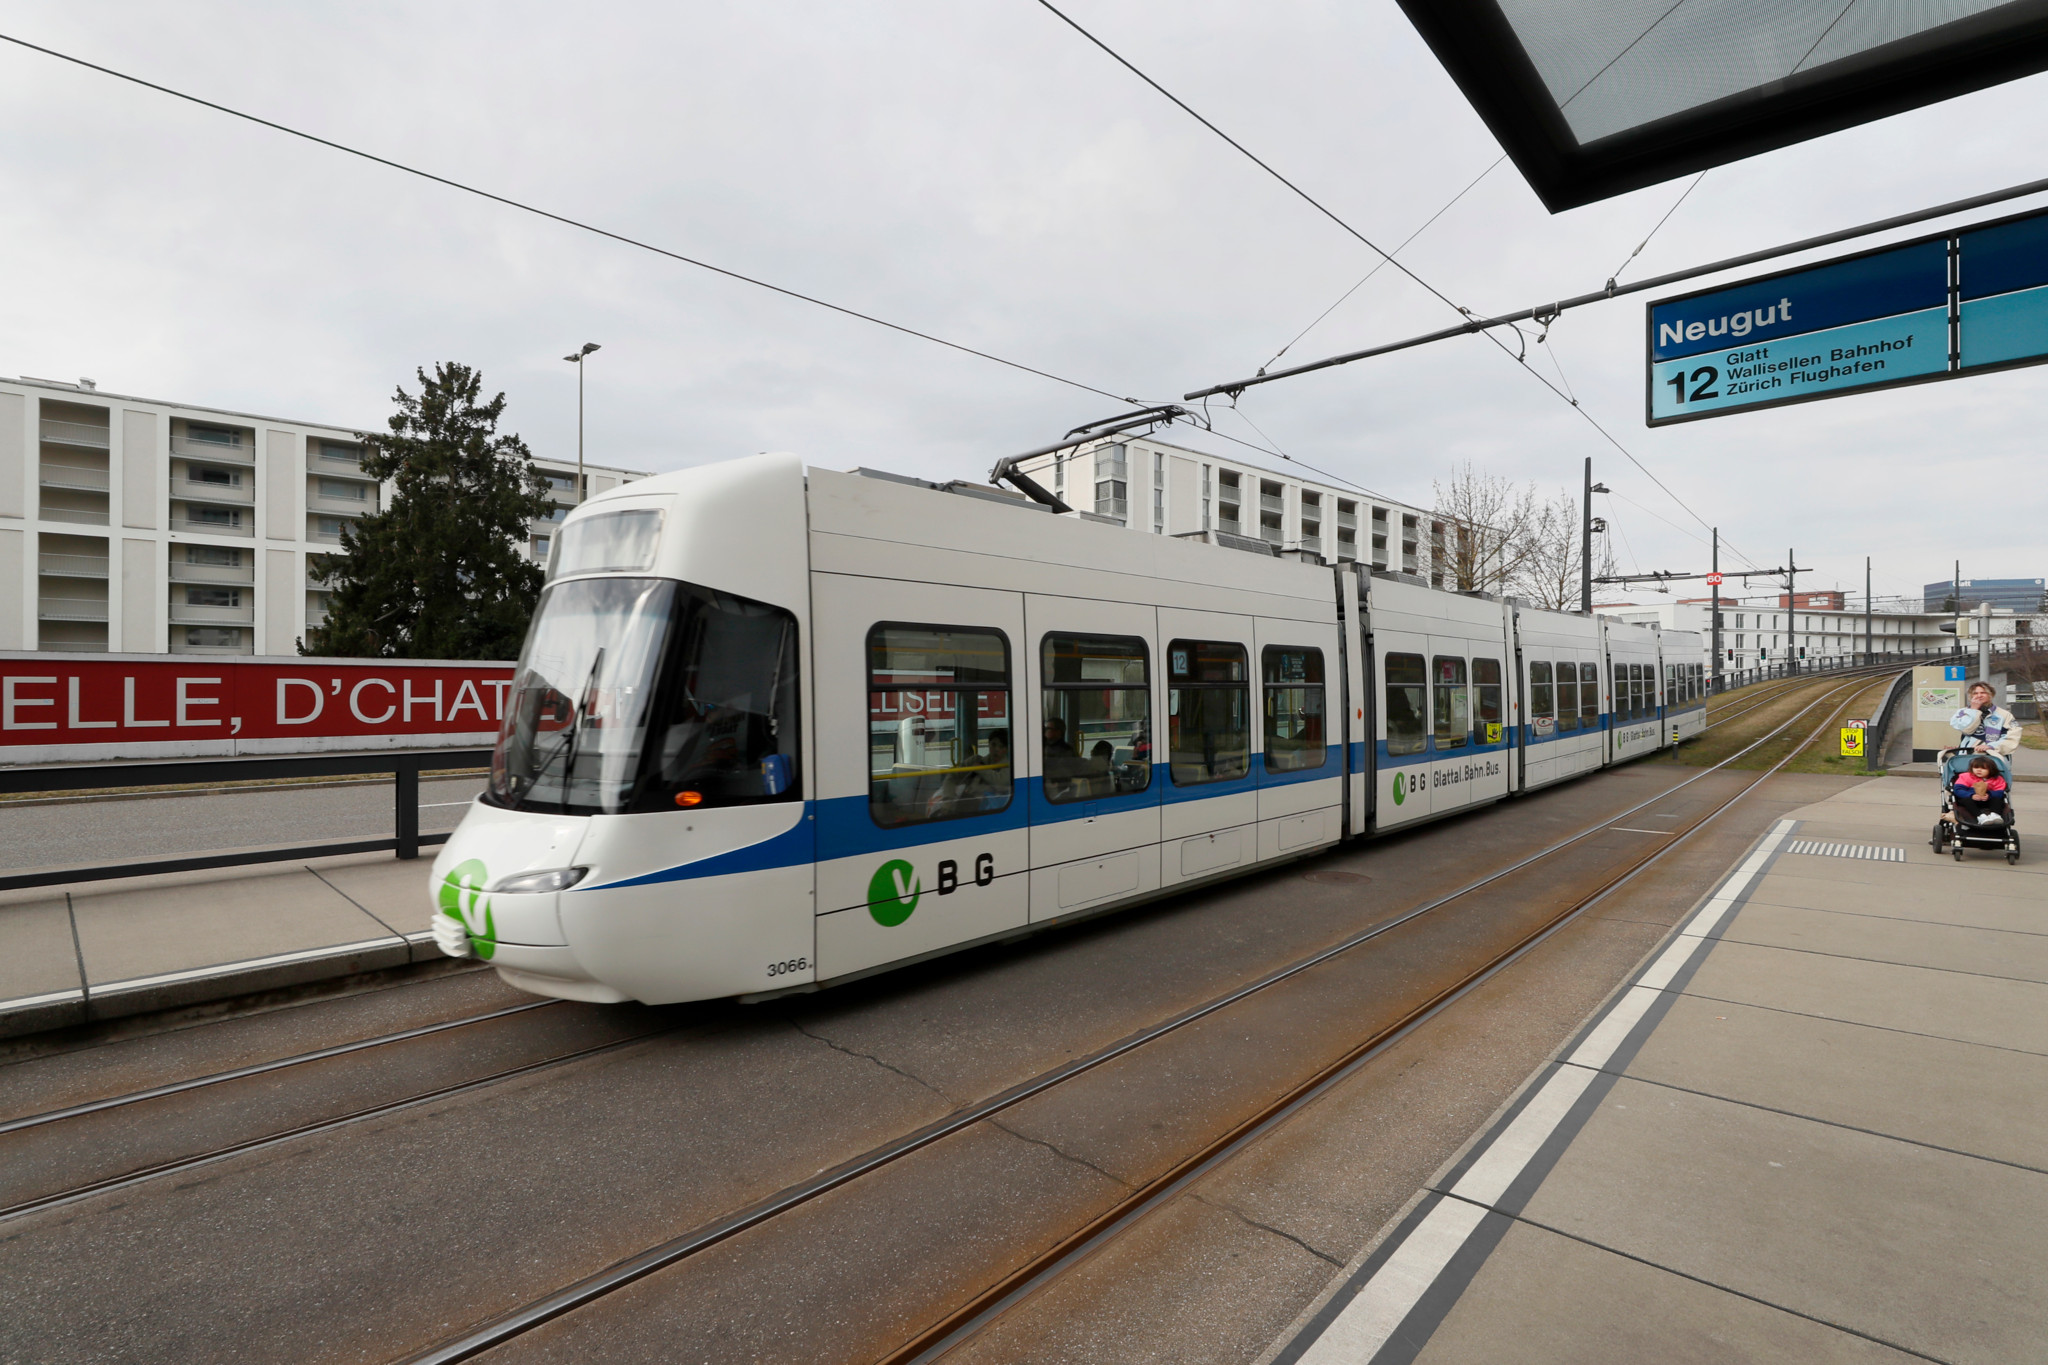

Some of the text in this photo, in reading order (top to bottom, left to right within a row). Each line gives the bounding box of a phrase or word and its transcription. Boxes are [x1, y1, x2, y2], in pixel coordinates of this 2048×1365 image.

[1660, 297, 1792, 347] Neugut
[1726, 348, 1769, 366] Glatt
[1727, 335, 1914, 381] Wallisellen Bahnhof
[1667, 366, 1719, 404] 12
[1726, 359, 1885, 396] Zürich Flughafen
[1707, 575, 1721, 583] 60
[1173, 655, 1186, 670] 12
[3, 676, 242, 735] ELLE,
[767, 957, 807, 977] 3066
